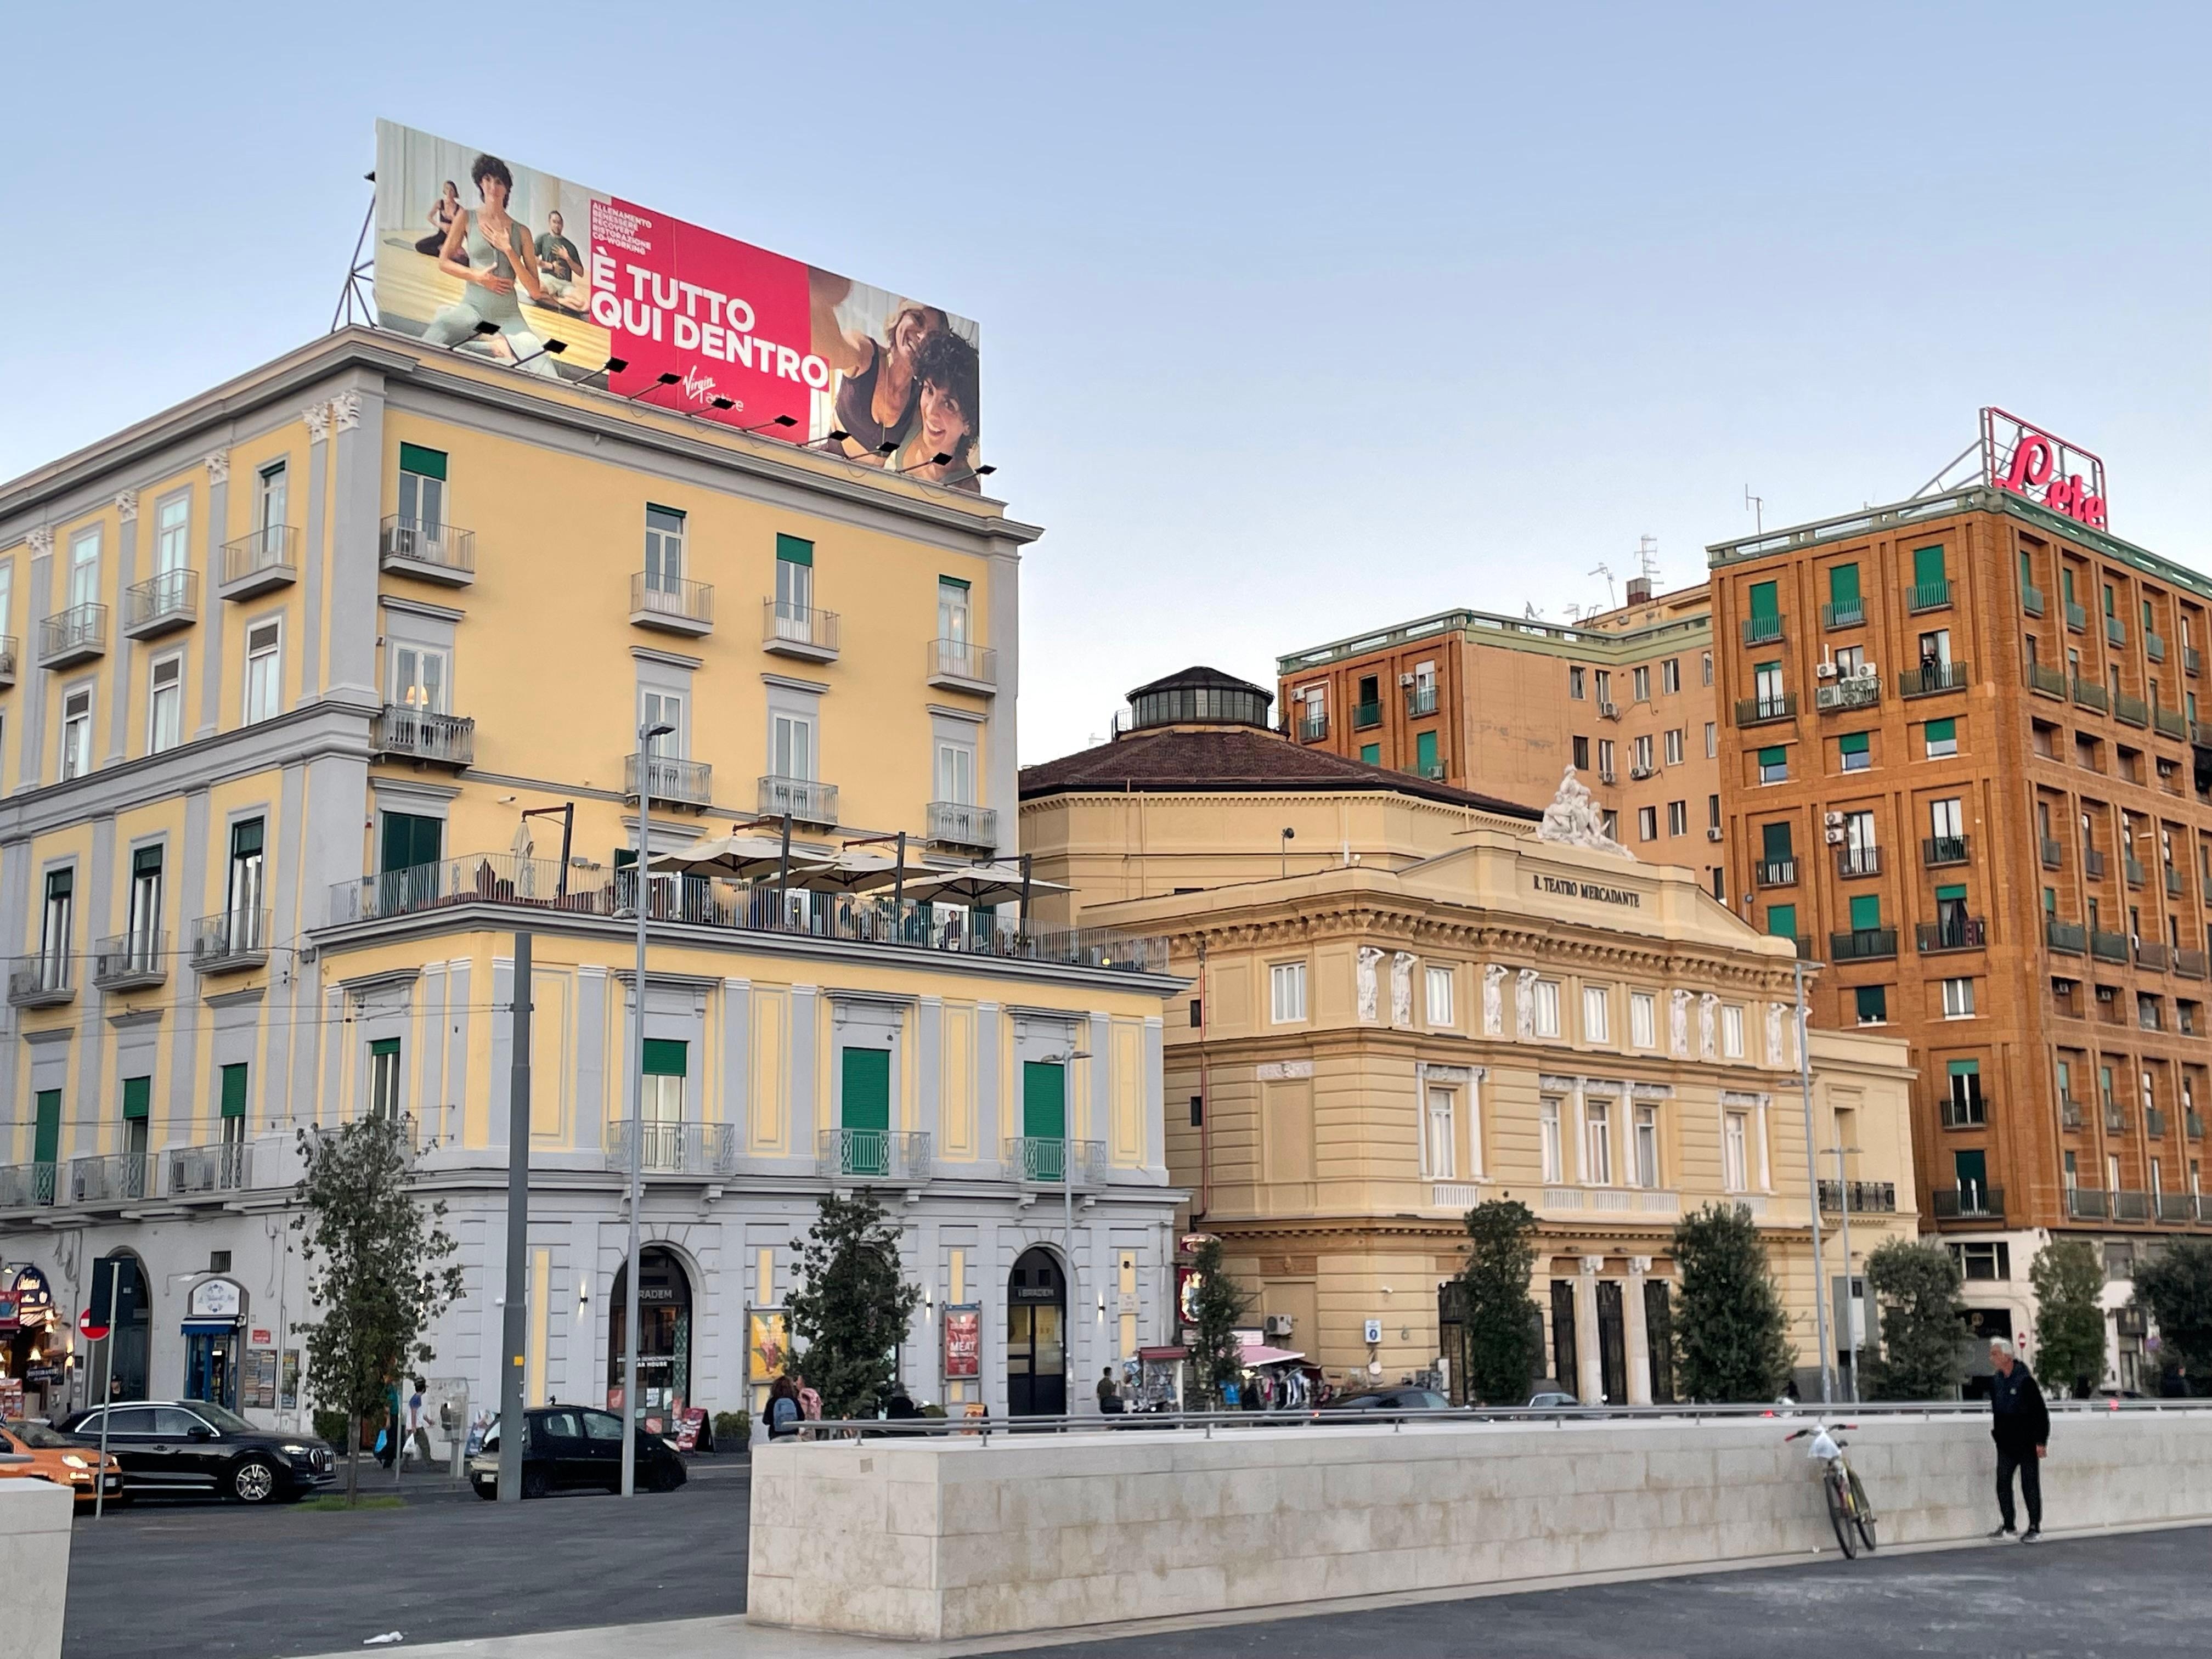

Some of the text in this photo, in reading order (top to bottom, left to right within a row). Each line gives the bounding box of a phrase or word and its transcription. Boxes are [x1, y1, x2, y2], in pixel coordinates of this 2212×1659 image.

[592, 202, 652, 229] ALLENAMENTO
[592, 209, 639, 232] BENESSERE
[592, 217, 635, 236] RECOVERY
[592, 224, 652, 251] RISTORAZIONE
[592, 232, 646, 255] CO-WORKING
[592, 246, 755, 333] È TUTTO
[591, 291, 829, 388] QUI DENTRO
[682, 365, 716, 404] Virgin
[1993, 435, 2105, 532] Pete
[1543, 877, 1577, 897] TEATRO
[1581, 883, 1640, 908] MERCADANTE
